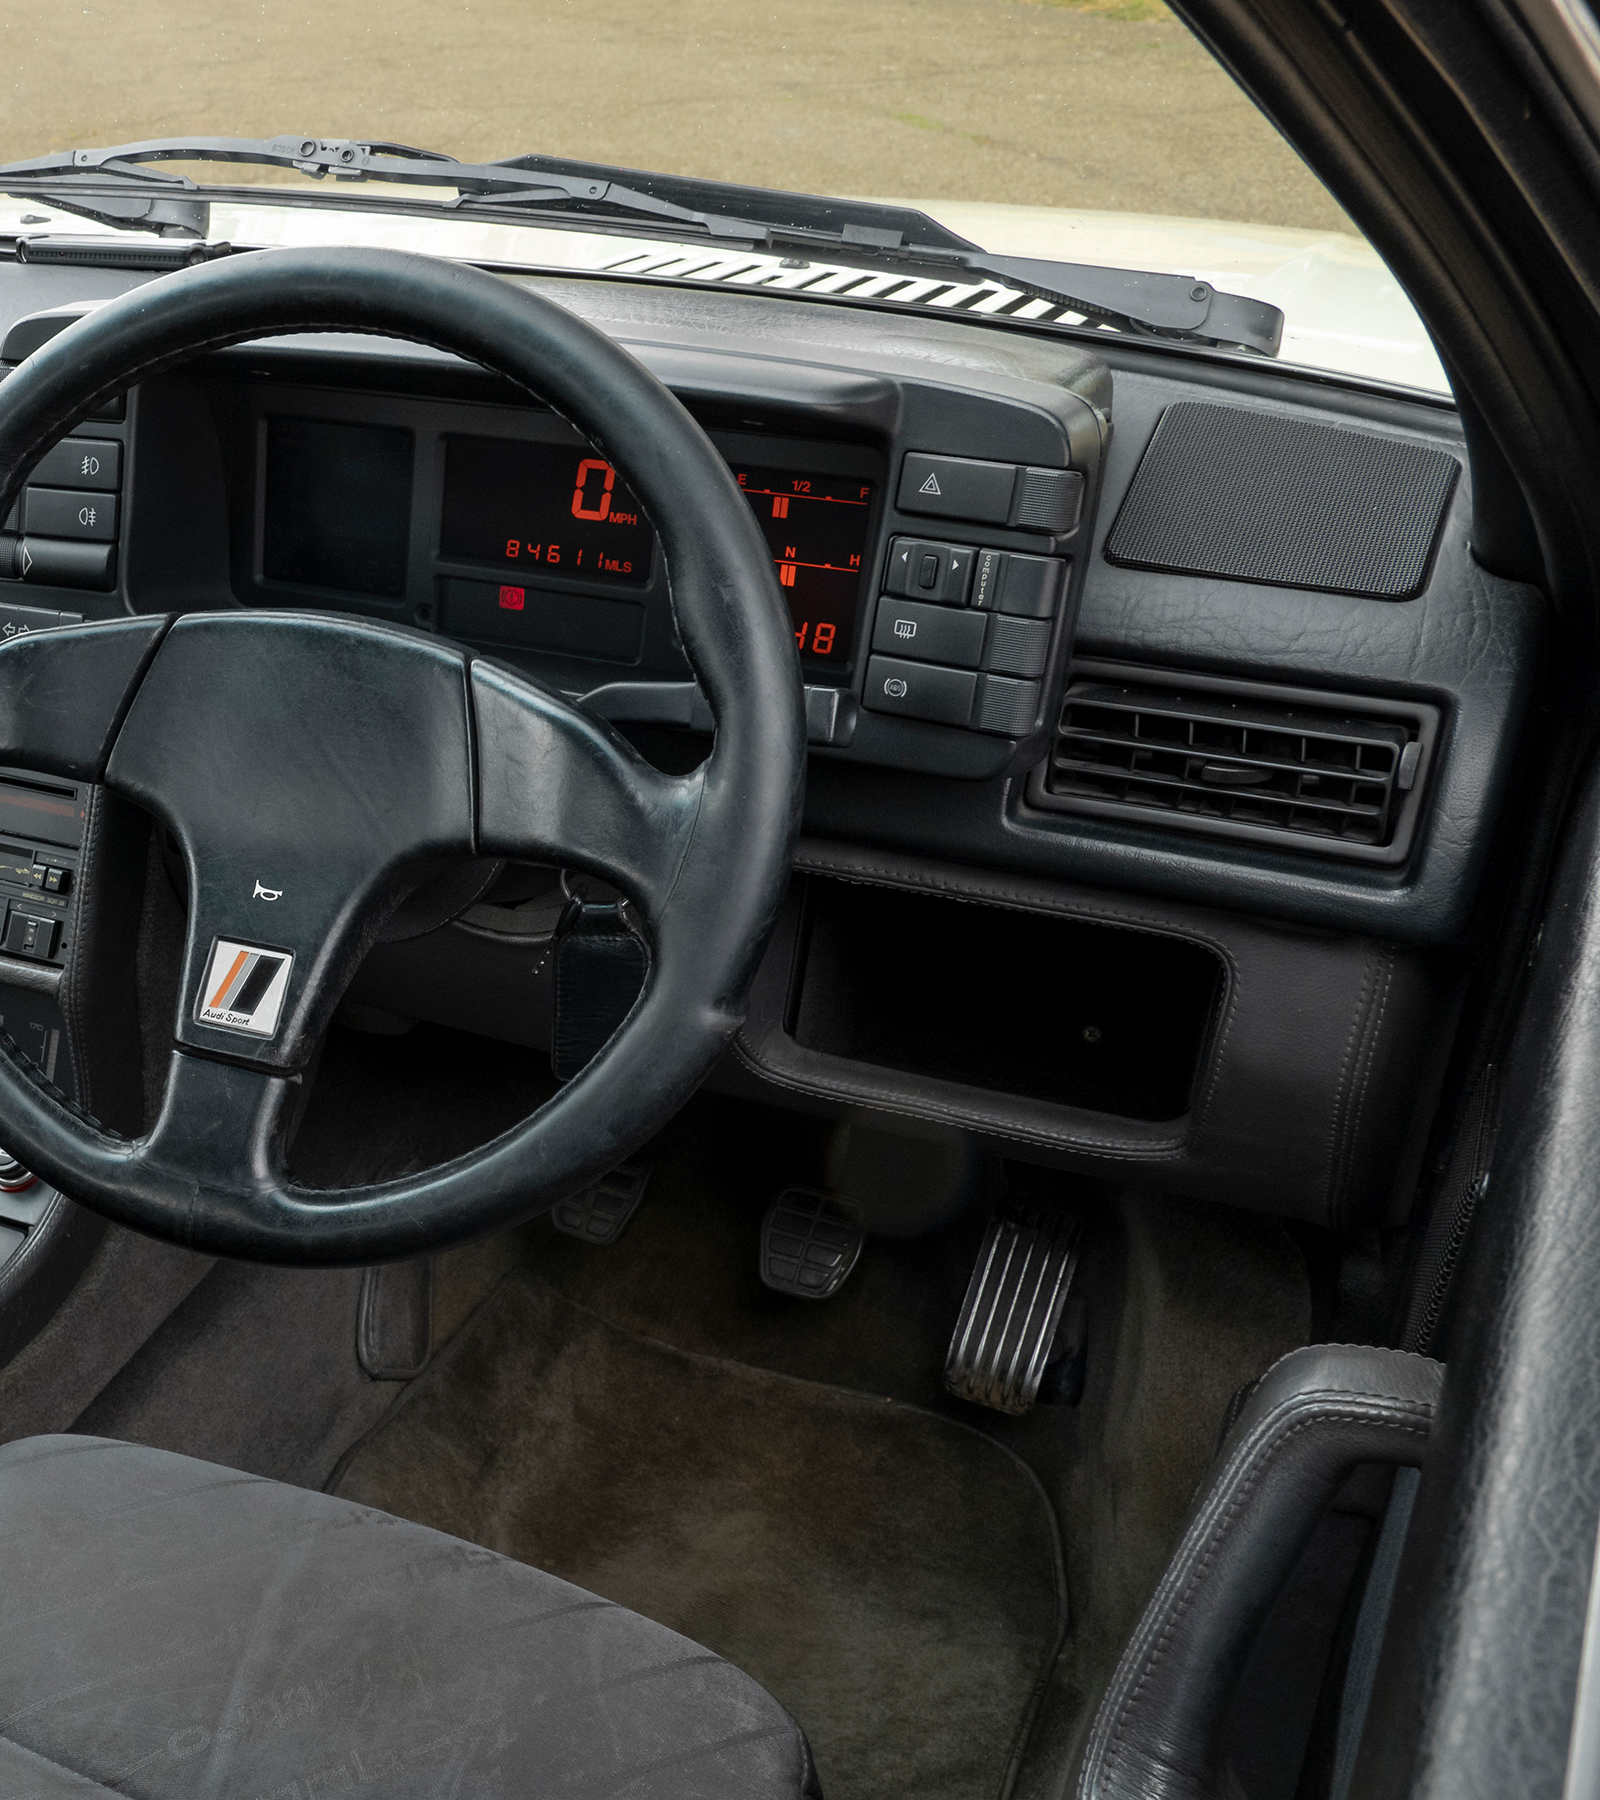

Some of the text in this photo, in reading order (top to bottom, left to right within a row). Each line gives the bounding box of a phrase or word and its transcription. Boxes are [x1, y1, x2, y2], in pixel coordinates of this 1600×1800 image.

[272, 144, 295, 154] BOSCH
[571, 458, 638, 526] 0 MPH
[738, 474, 870, 498] E 1/2 F
[785, 546, 861, 567] N H
[605, 559, 632, 573] MLS
[889, 684, 901, 692] ABS
[203, 1009, 250, 1026] Audi Sport
[28, 1022, 44, 1032] 170
